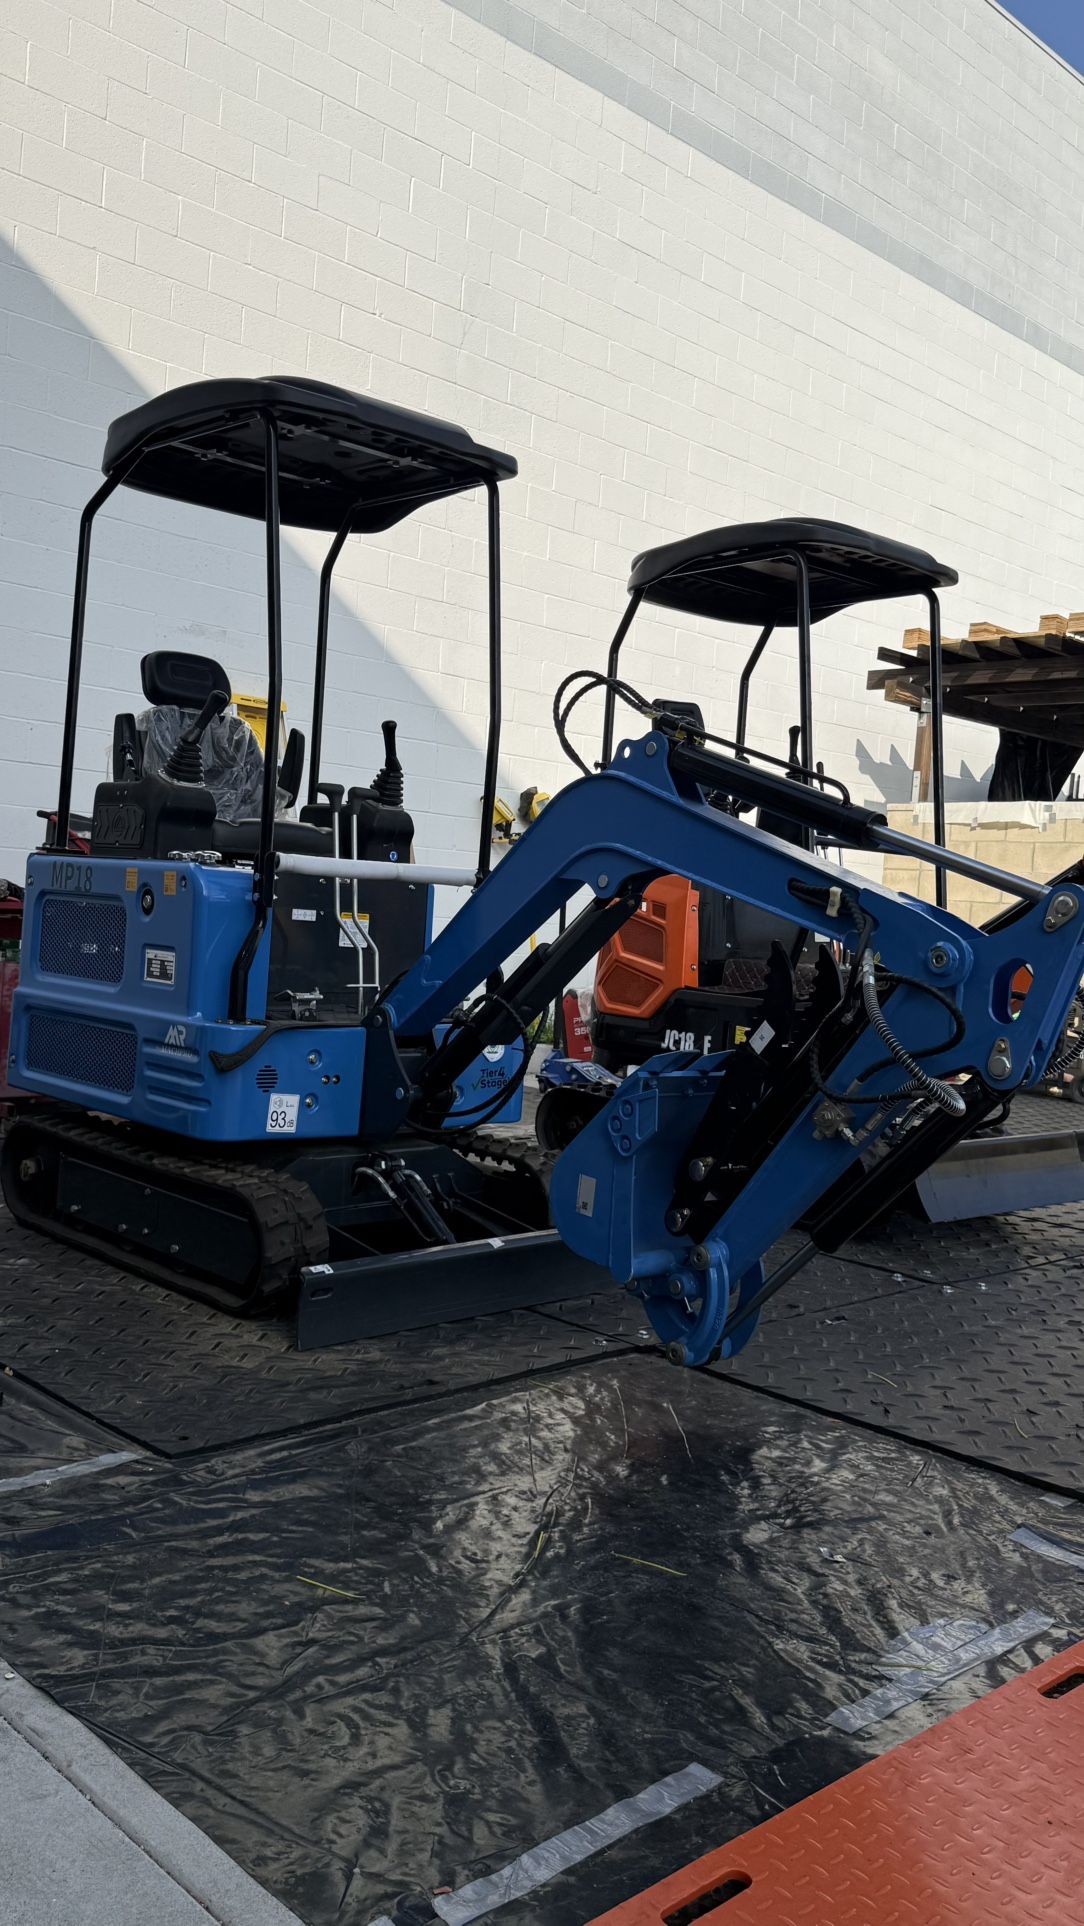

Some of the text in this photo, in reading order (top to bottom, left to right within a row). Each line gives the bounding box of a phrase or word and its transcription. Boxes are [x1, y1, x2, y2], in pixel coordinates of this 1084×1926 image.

[51, 861, 93, 891] MP18
[660, 1028, 695, 1051] JC18
[480, 1078, 508, 1089] Stage
[270, 1110, 287, 1128] 93
